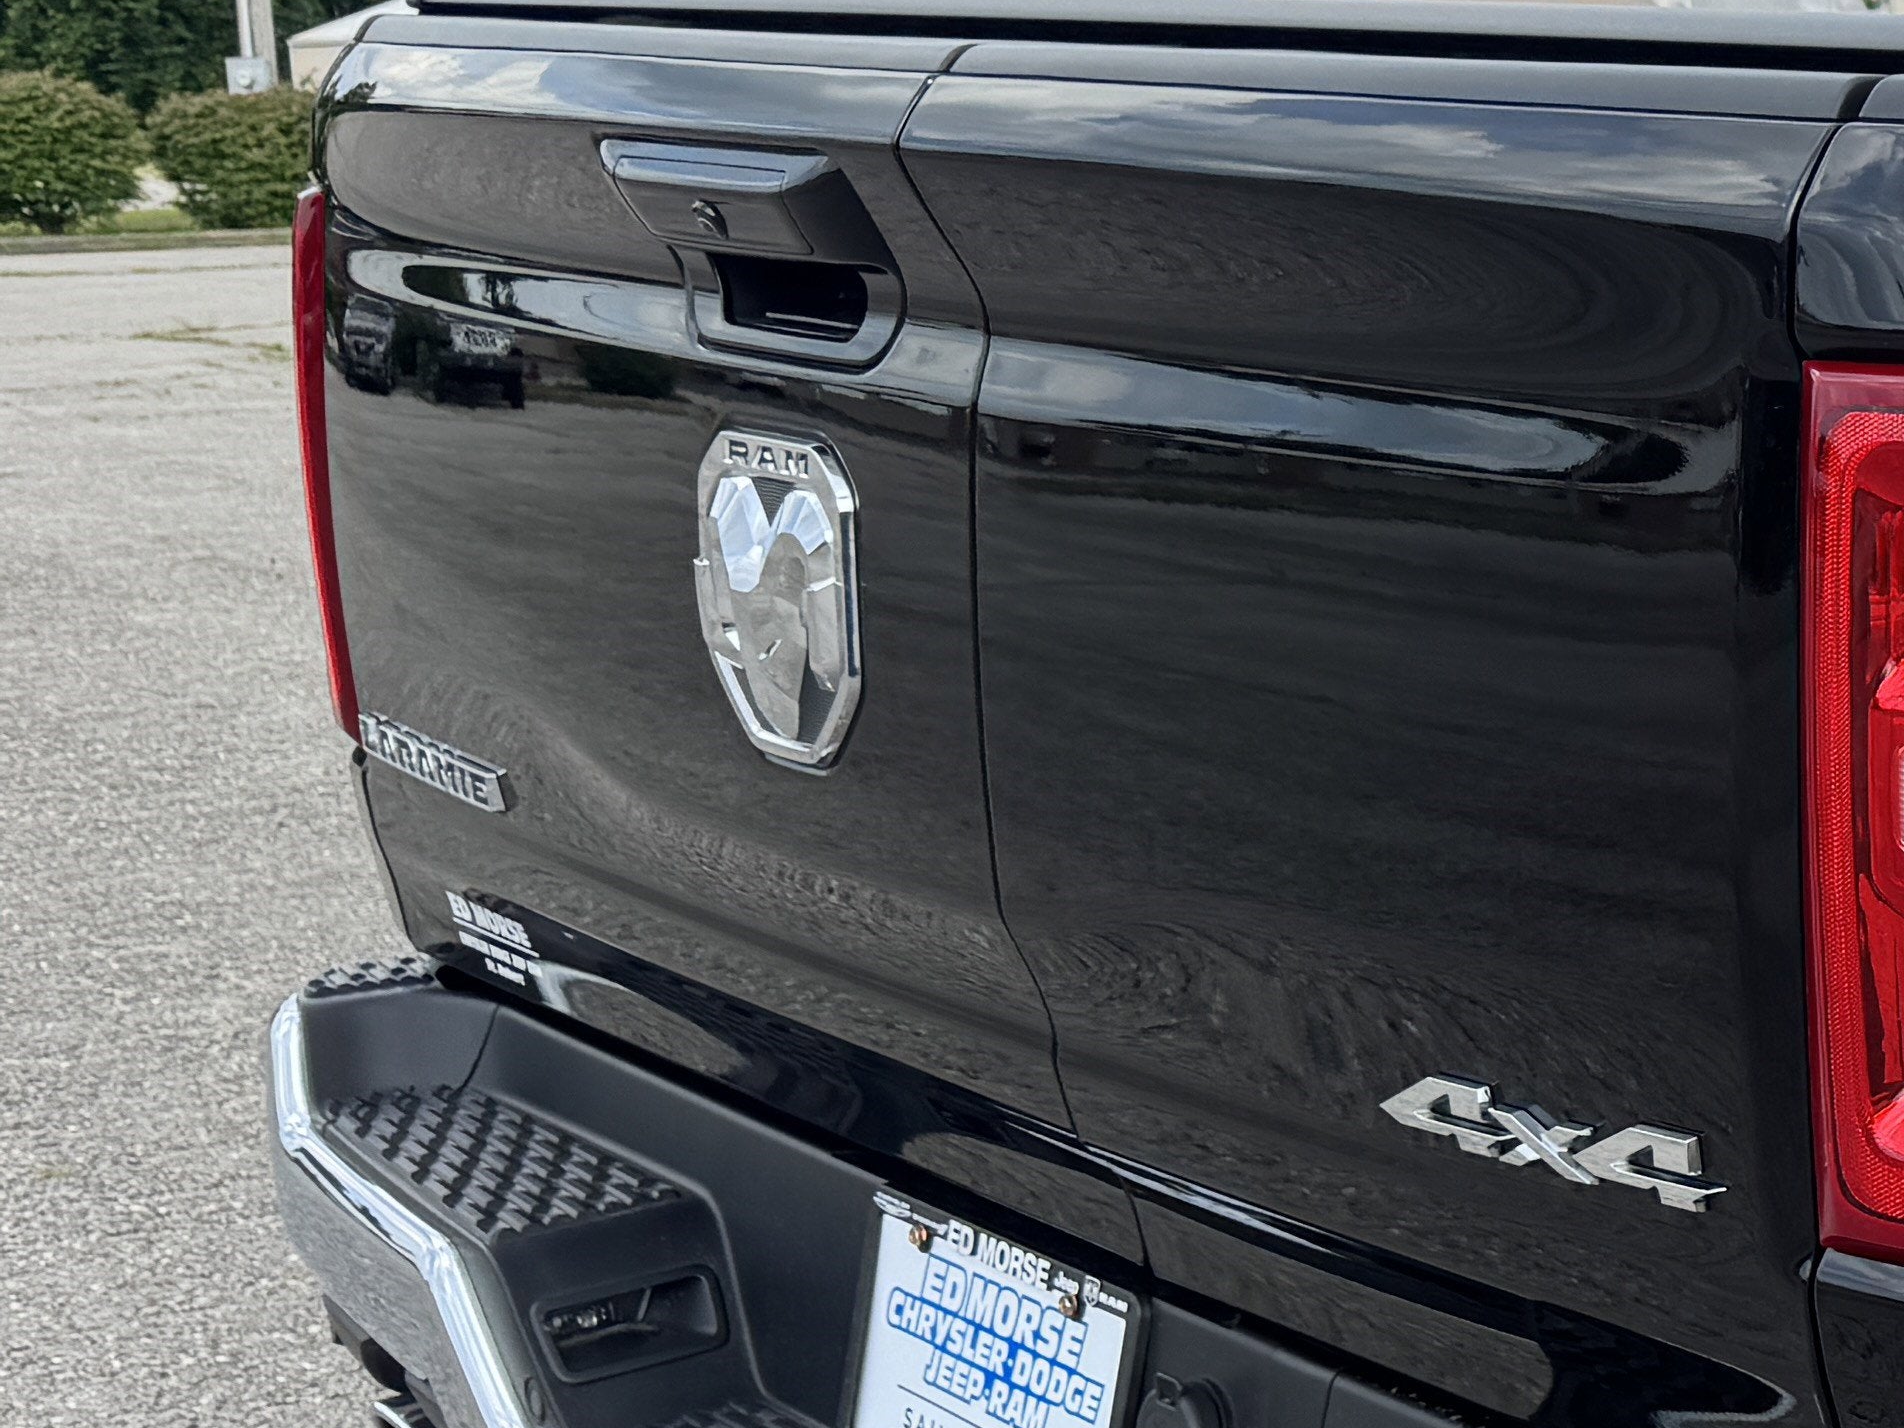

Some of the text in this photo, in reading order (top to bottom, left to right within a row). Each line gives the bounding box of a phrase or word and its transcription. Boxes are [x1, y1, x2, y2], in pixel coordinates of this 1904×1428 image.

[723, 438, 810, 480] RAM
[361, 717, 491, 807] LARAMIE
[947, 1218, 975, 1257] ED
[977, 1232, 1052, 1291] MORSE
[922, 1253, 1089, 1370] ED MORSE
